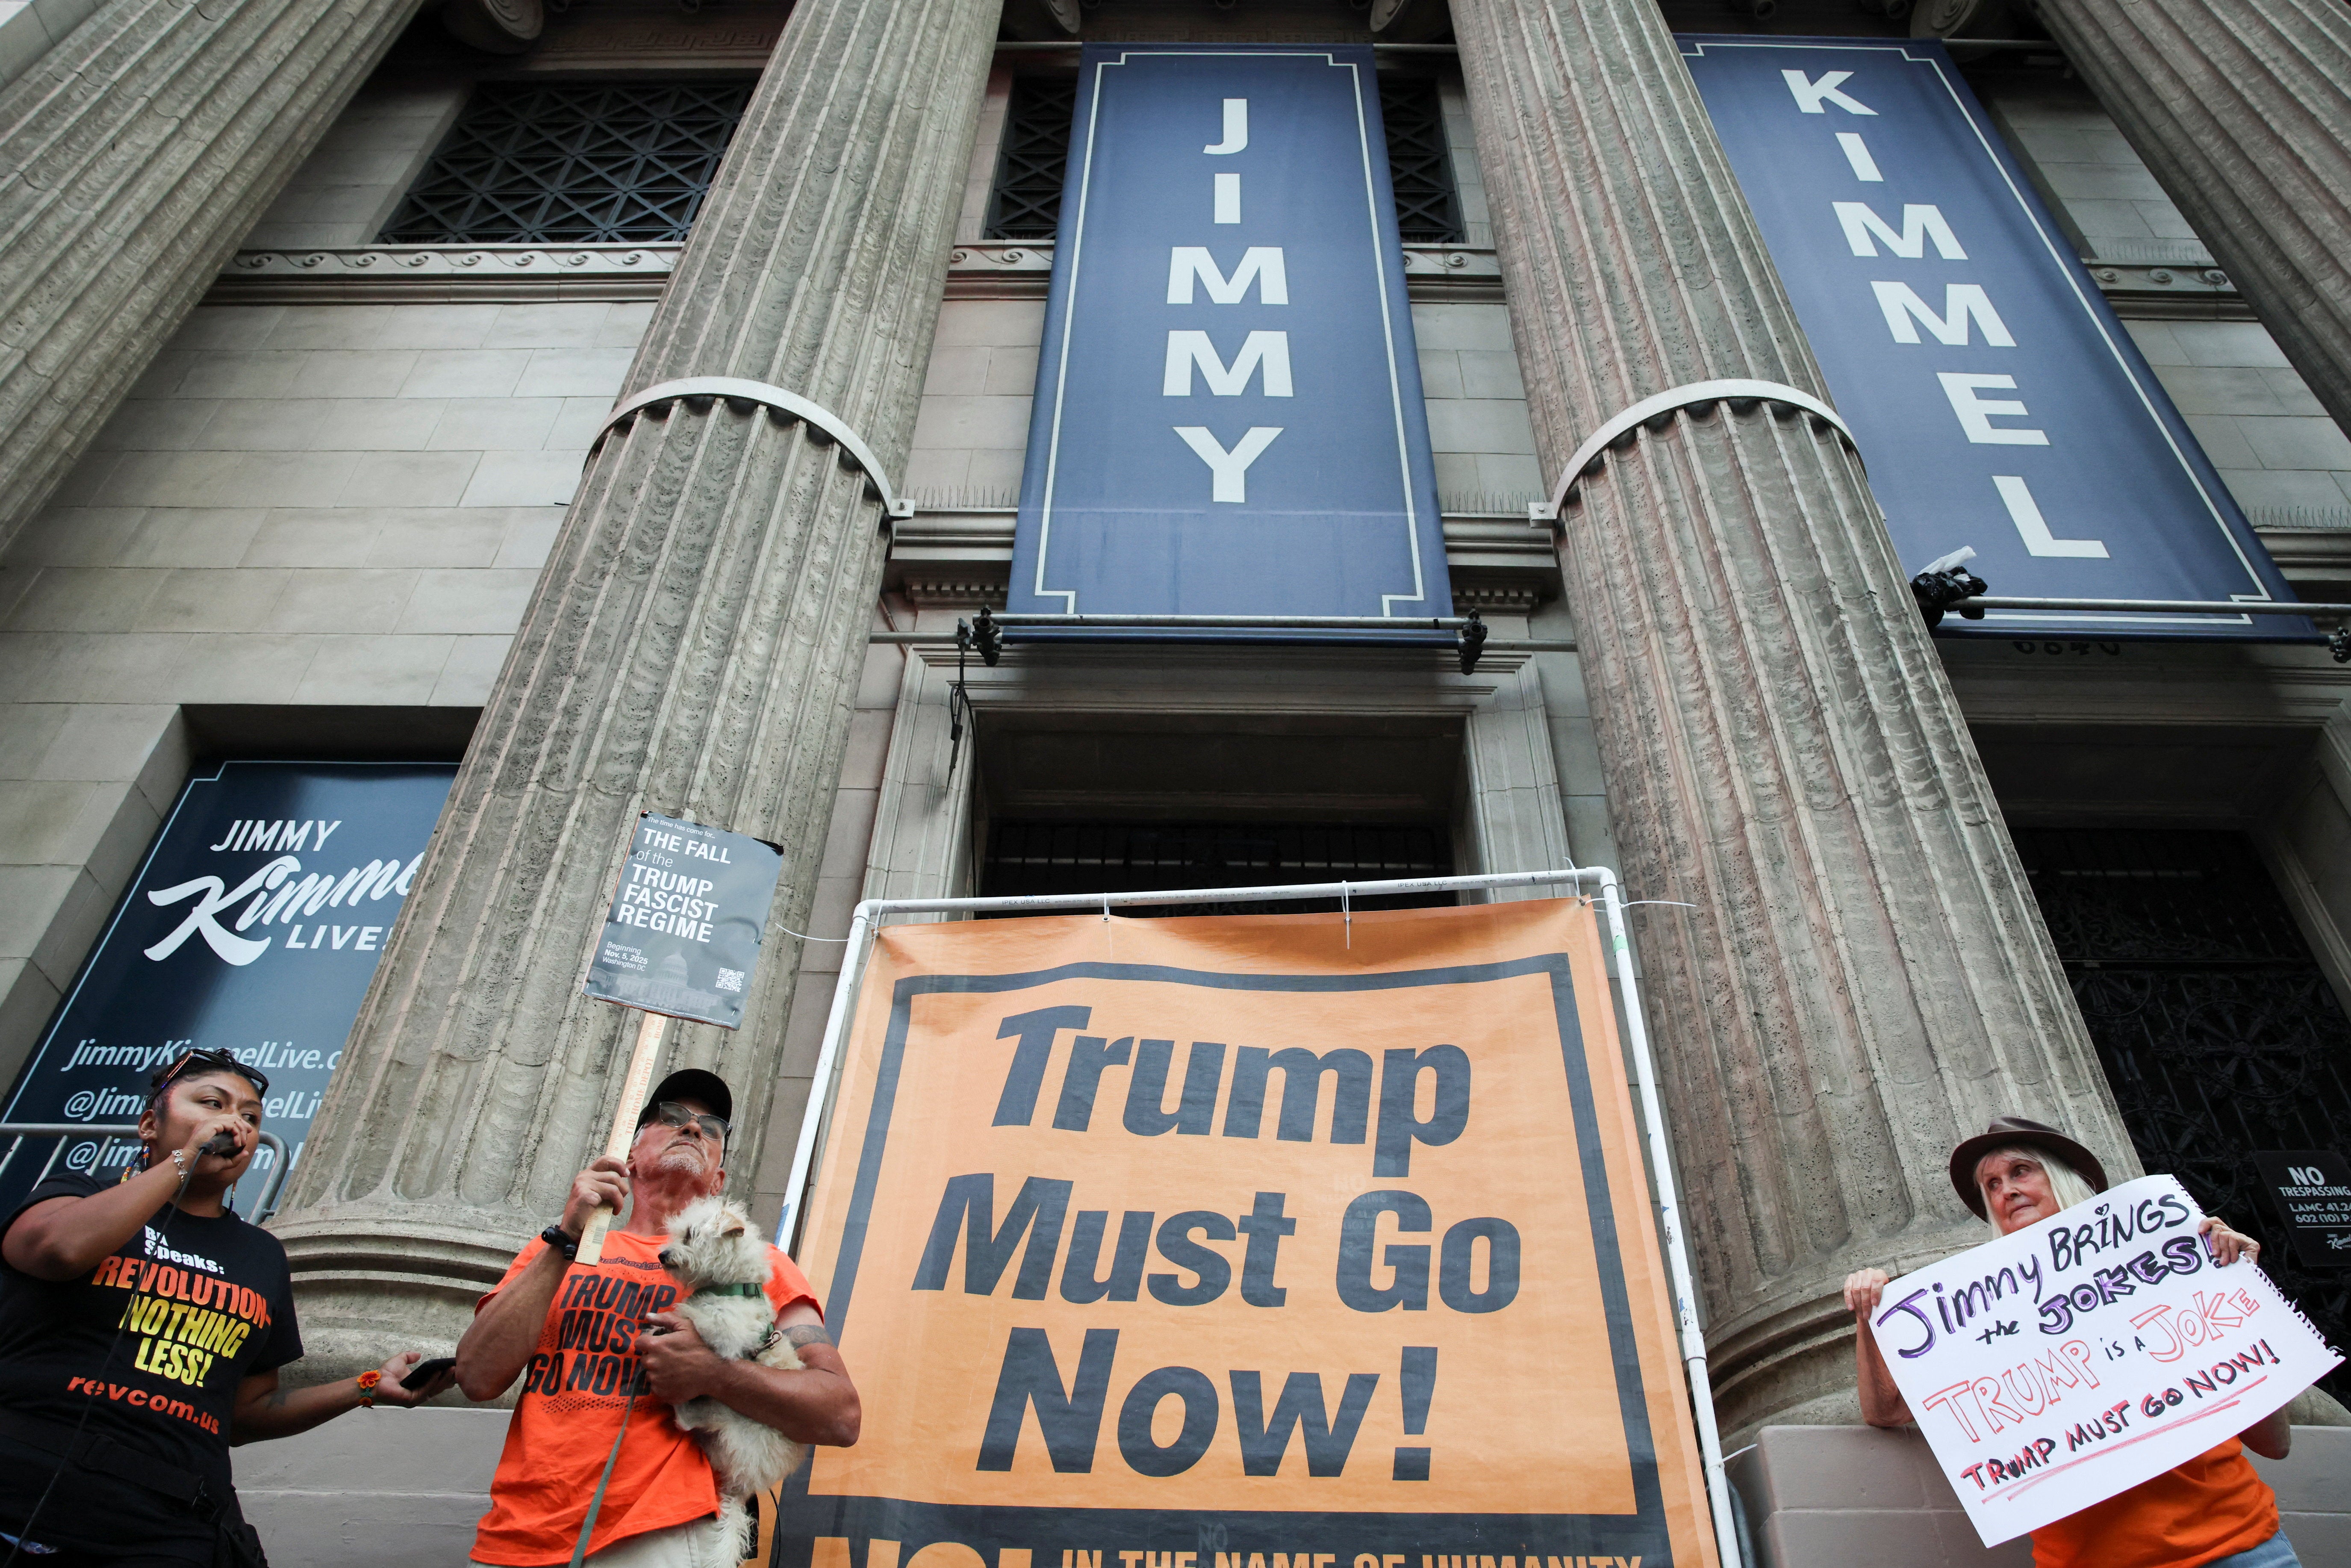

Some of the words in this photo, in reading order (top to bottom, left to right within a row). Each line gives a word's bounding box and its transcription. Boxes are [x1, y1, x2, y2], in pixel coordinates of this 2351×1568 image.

[1163, 98, 1293, 503] JIMMY
[1781, 69, 2110, 558] KIMMEL
[210, 819, 342, 852] JIMMY
[648, 816, 659, 825] The
[660, 819, 673, 828] time
[674, 823, 686, 831] has
[686, 826, 703, 835] come
[636, 849, 651, 861] of
[652, 852, 673, 868] the
[644, 828, 683, 853] THE
[685, 839, 731, 864] FALL
[632, 863, 713, 898] TRUMP
[144, 851, 426, 966] Kimme
[623, 883, 719, 921] FASCIST
[616, 903, 714, 943] REGIME
[603, 956, 636, 969] Washington
[604, 949, 620, 958] Nov.
[630, 955, 648, 964] 2025
[607, 941, 642, 956] Beginning
[654, 1018, 665, 1039] HOME
[625, 1117, 637, 1135] THE
[631, 1088, 645, 1115] HOME
[639, 1057, 654, 1086] DEPOT
[992, 1005, 1471, 1179] Trump
[2278, 1186, 2351, 1197] TRESPASSING
[2287, 1166, 2325, 1186] NO
[2289, 1203, 2324, 1212] LAMC
[2295, 1214, 2318, 1223] 602
[2319, 1214, 2340, 1223] (10)
[145, 1225, 169, 1247] BA
[911, 1172, 1296, 1308] Must
[1336, 1190, 1521, 1314] Go
[144, 1240, 225, 1275] Speaks:
[559, 1274, 677, 1320] TRUMP
[1877, 1254, 2042, 1358] Jimmy
[119, 1294, 251, 1359] NOTHING
[1975, 1320, 2020, 1344] the
[134, 1337, 214, 1388] LESS!
[524, 1352, 565, 1396] GO
[1922, 1340, 2101, 1444] TRUMP
[2100, 1338, 2125, 1361] is
[2129, 1288, 2260, 1363] JOKE
[67, 1375, 219, 1435] revcom.us
[975, 1326, 1438, 1481] Now!
[1960, 1438, 2056, 1491] TRUMP
[2064, 1400, 2131, 1453] MUST
[2140, 1387, 2184, 1418] GO
[2183, 1338, 2280, 1399] NOW!
